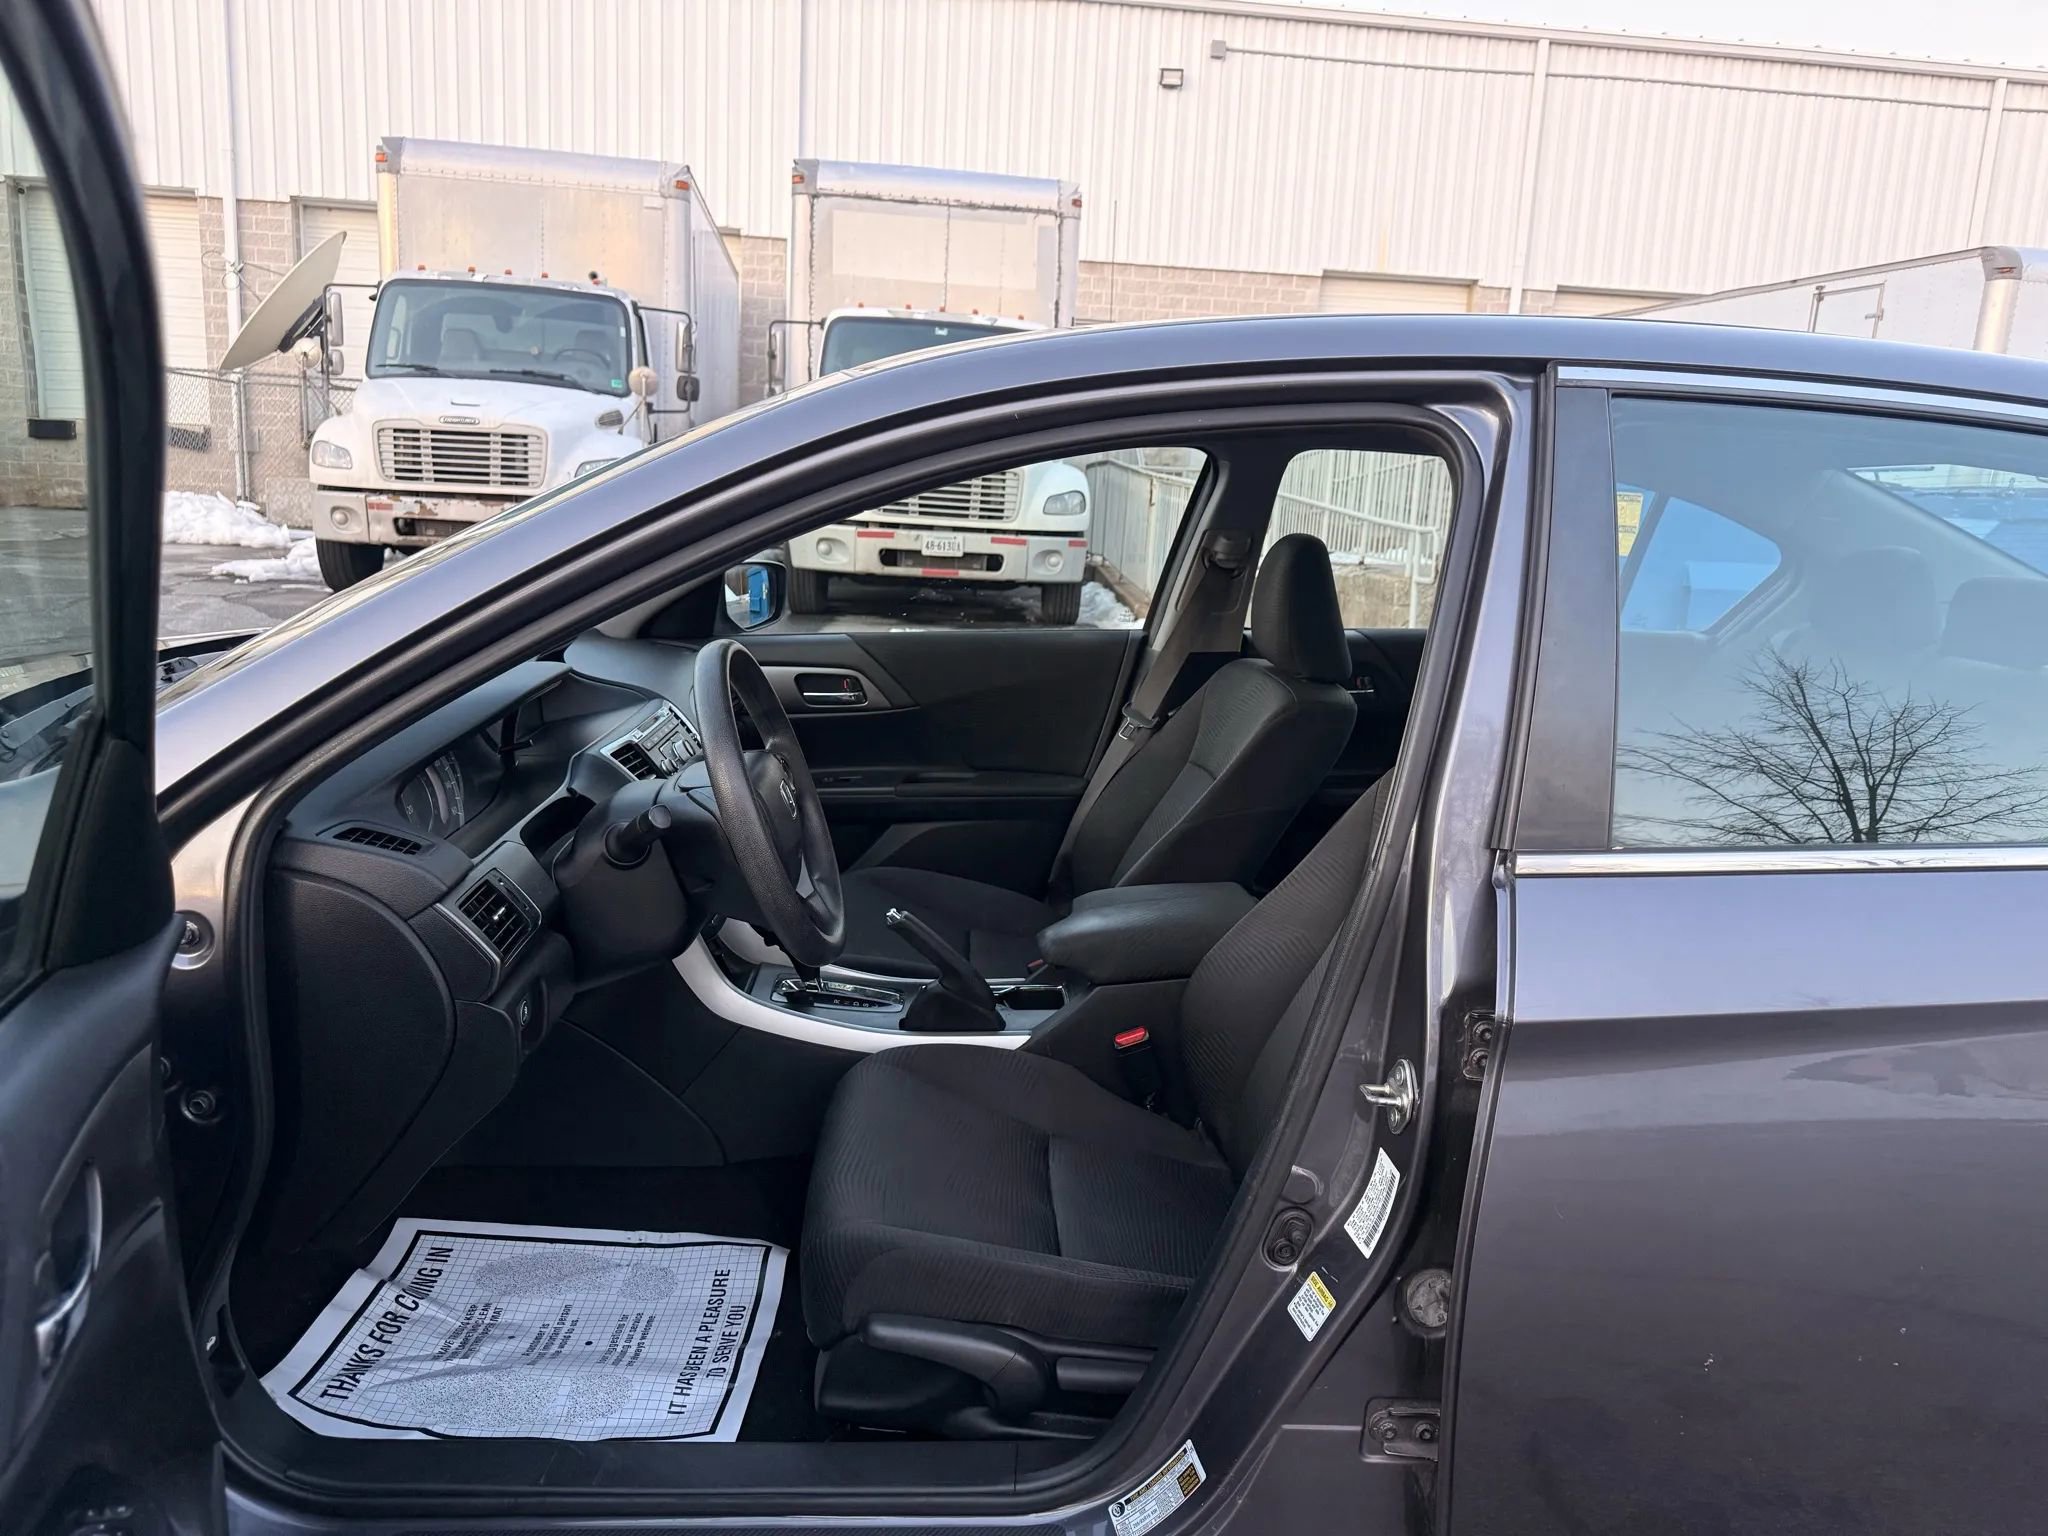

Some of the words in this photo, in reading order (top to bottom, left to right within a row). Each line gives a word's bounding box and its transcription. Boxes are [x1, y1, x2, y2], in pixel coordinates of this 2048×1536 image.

[464, 1304, 478, 1320] KEEP
[698, 1269, 731, 1332] PLEASURE
[319, 1343, 386, 1400] THANKS
[368, 1310, 411, 1344] FOR
[424, 1246, 454, 1263] IN
[557, 1304, 573, 1326] person
[724, 1305, 747, 1329] YOU
[695, 1335, 713, 1344] A
[712, 1331, 739, 1365] SERVE
[667, 1400, 687, 1415] IT
